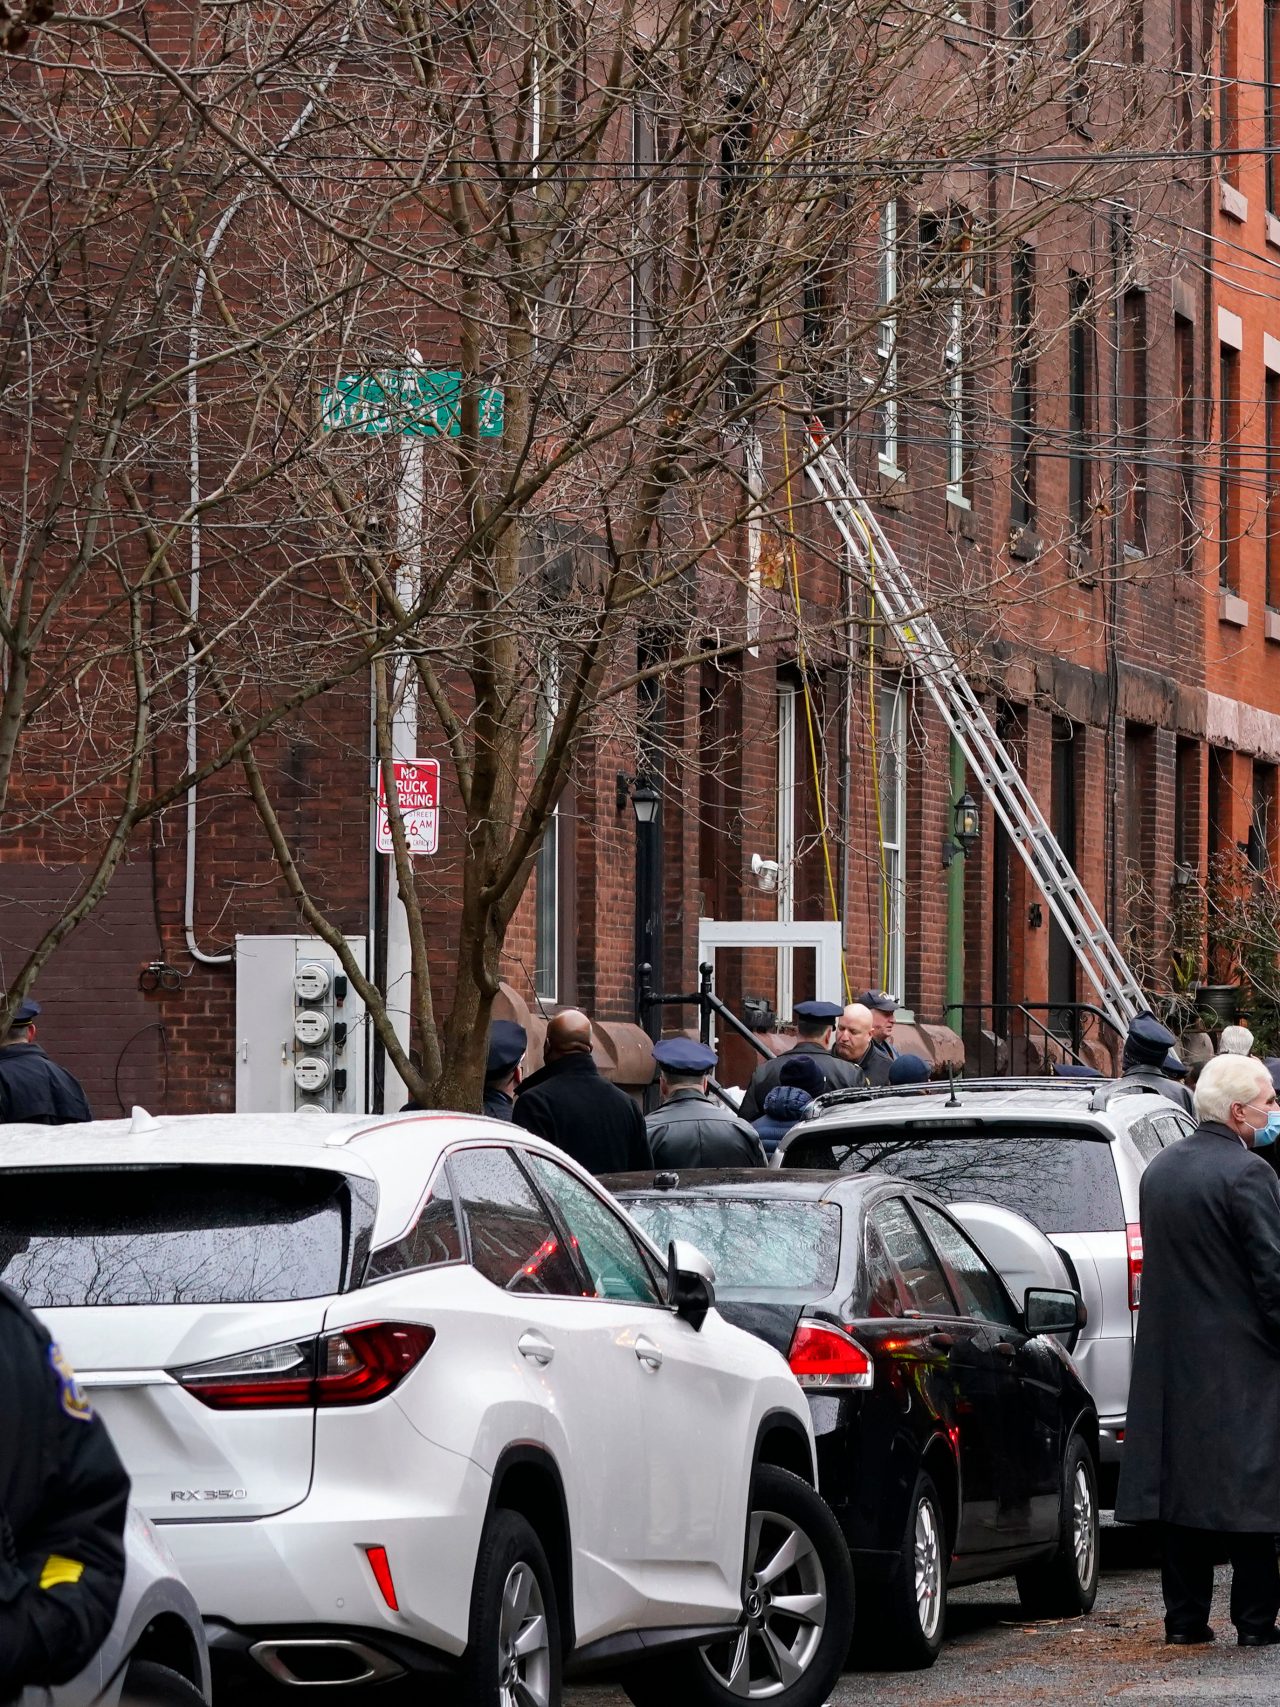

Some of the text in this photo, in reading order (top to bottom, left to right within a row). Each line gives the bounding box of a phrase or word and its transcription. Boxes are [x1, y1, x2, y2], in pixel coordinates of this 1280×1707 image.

[400, 767, 418, 780] NO
[396, 780, 428, 793] RUCK
[383, 793, 433, 806] RKING
[410, 820, 418, 836] 6
[419, 820, 433, 828] AM
[170, 1488, 248, 1502] RX 350
